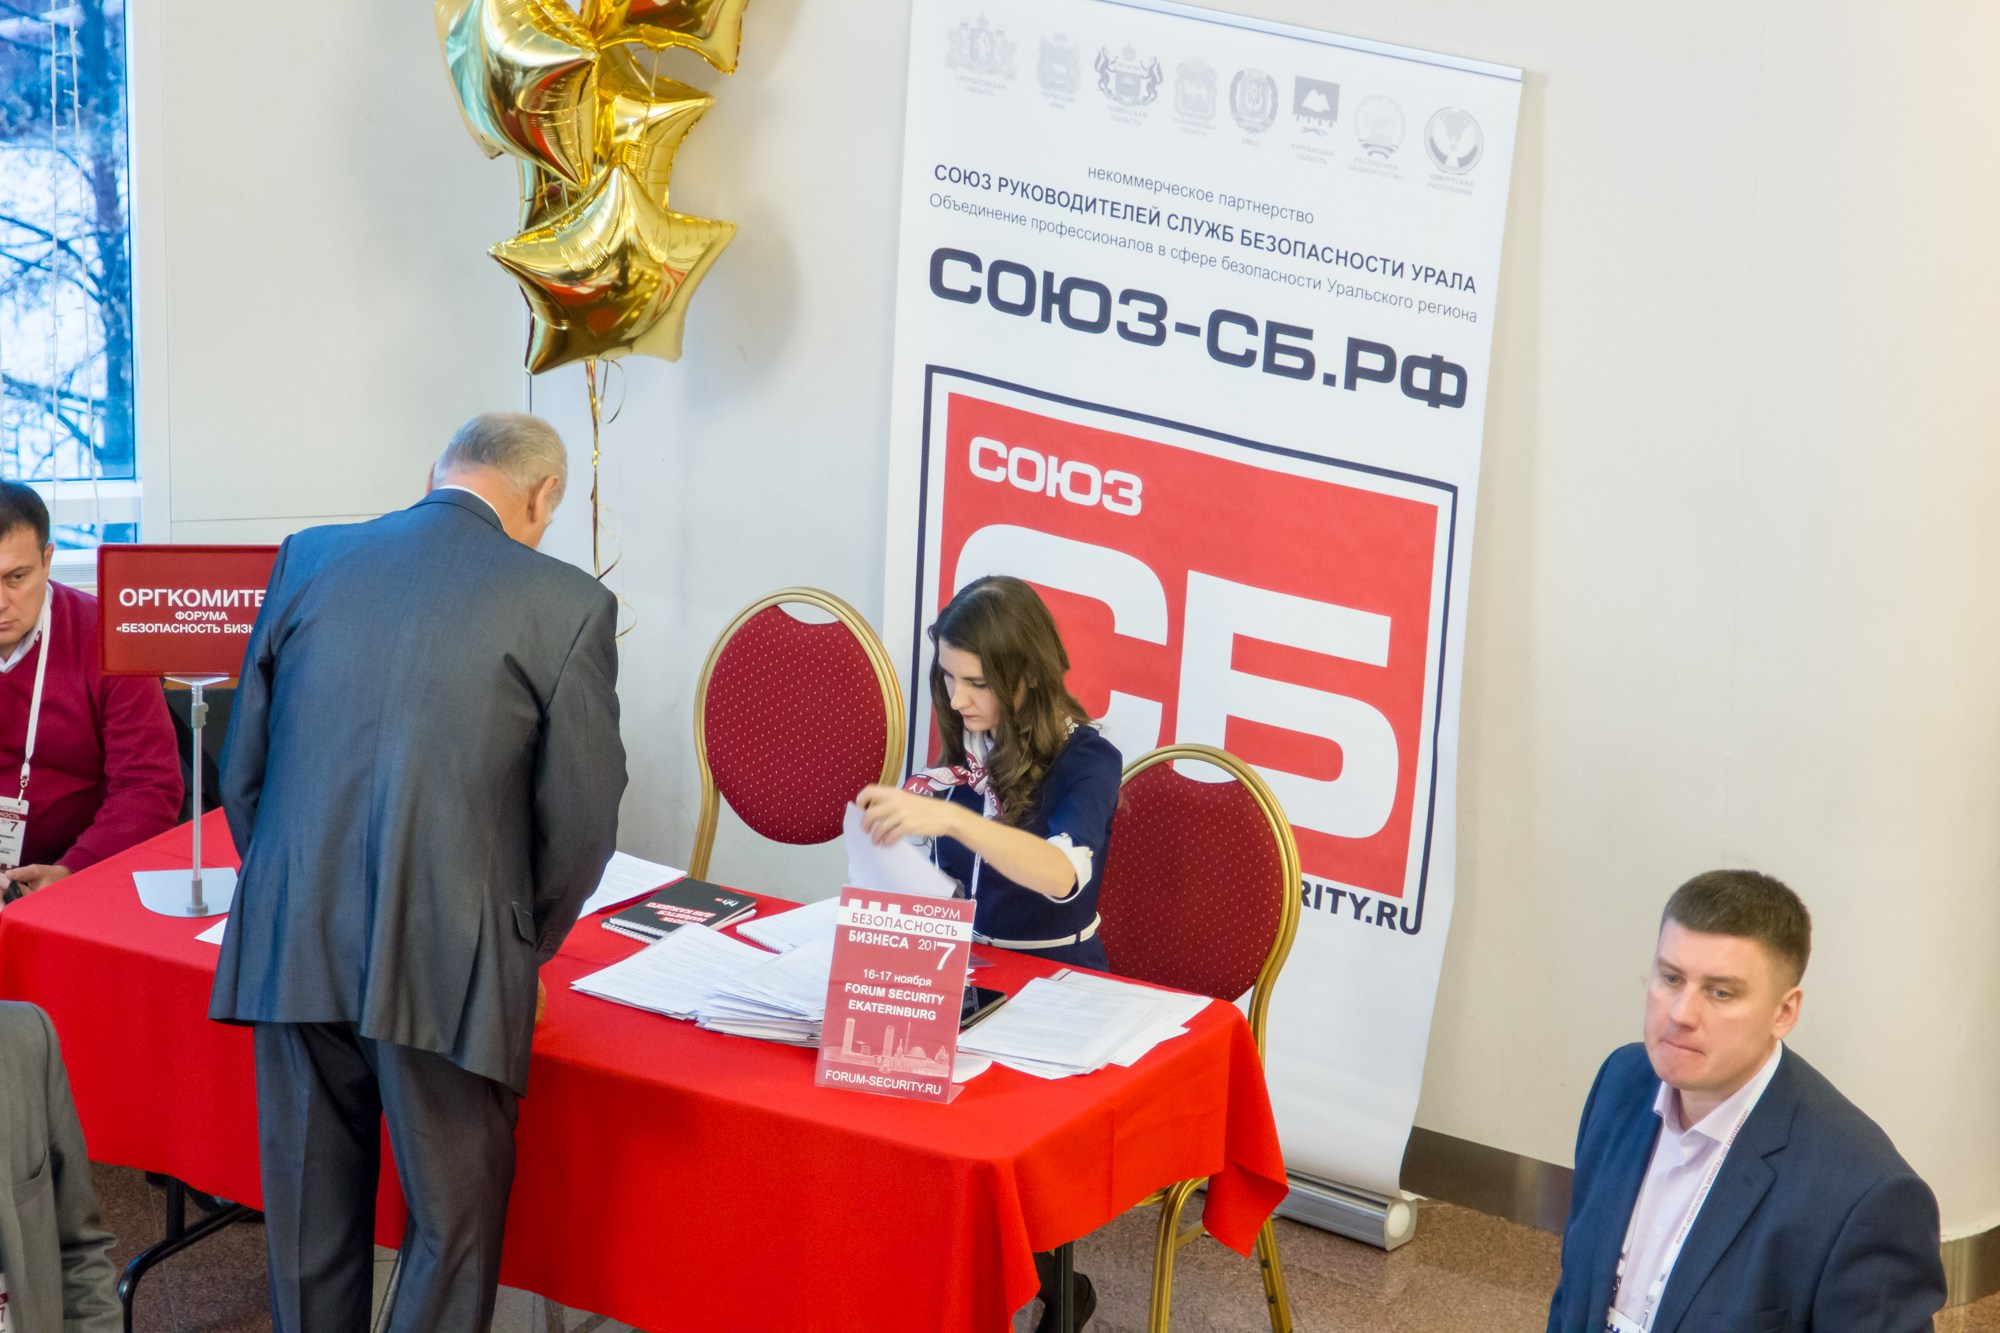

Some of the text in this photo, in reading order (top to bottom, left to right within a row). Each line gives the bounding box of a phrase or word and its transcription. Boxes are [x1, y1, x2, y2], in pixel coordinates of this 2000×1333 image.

[1088, 166, 1314, 224] некоммерческое партнерство
[934, 164, 1477, 294] СОЮЗ РУКОВОДИТЕЛЕЙ СЛУЖБ БЕЗОПАСНОСТИ УРАЛА
[929, 193, 1478, 323] Объединение профессионалов в сфере безопасности Уральского региона
[929, 247, 1468, 409] СОЮЗ-СБ.РФ
[968, 436, 1143, 517] СОЮЗ
[118, 588, 267, 607] ОРГКОМИТЕ
[116, 623, 255, 634] «БЕЗОПАСНОСТЬ БИЗ
[174, 610, 228, 621] ФОРУМА
[952, 523, 1399, 839] СБ
[912, 904, 961, 920] ФОРУМ
[1300, 879, 1421, 936] RITY.RU
[851, 912, 958, 937] БЕЗОПАСНОСТЬ
[849, 929, 956, 971] БИЗНЕСА 2017
[863, 968, 932, 987] 16-17 ноября
[845, 983, 945, 1005] FORUM SECURITY
[848, 999, 937, 1021] EKATERINBURG
[825, 1069, 942, 1095] FORUM-SECURITY.RU
